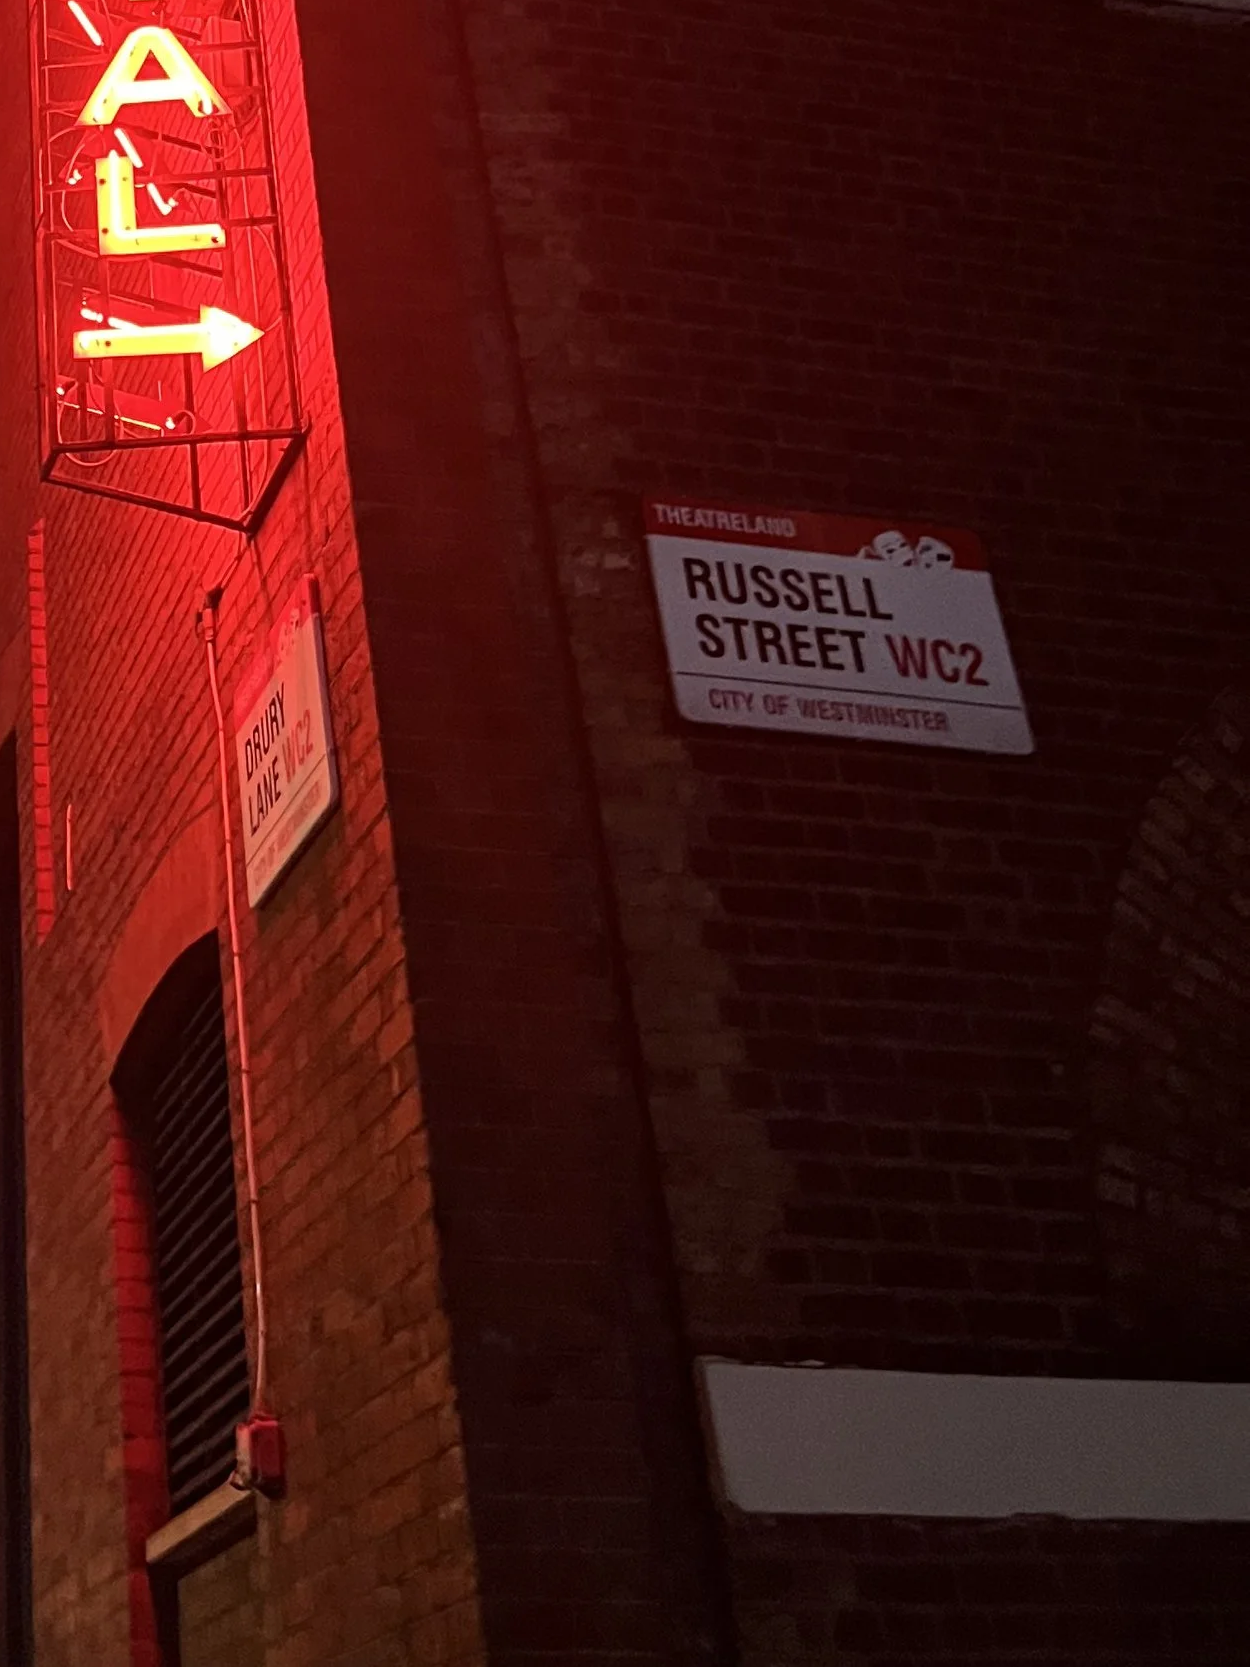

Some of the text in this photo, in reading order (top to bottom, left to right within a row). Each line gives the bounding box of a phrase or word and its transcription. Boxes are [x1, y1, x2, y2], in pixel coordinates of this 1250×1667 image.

[653, 503, 797, 538] THEATRELAND
[682, 557, 893, 621] RUSSELL
[695, 613, 990, 687] STREET WC2
[244, 682, 286, 783] DRURY
[708, 687, 948, 733] CITY OF WESTMINSTER
[248, 756, 282, 837] LANE
[281, 708, 314, 784] WC2
